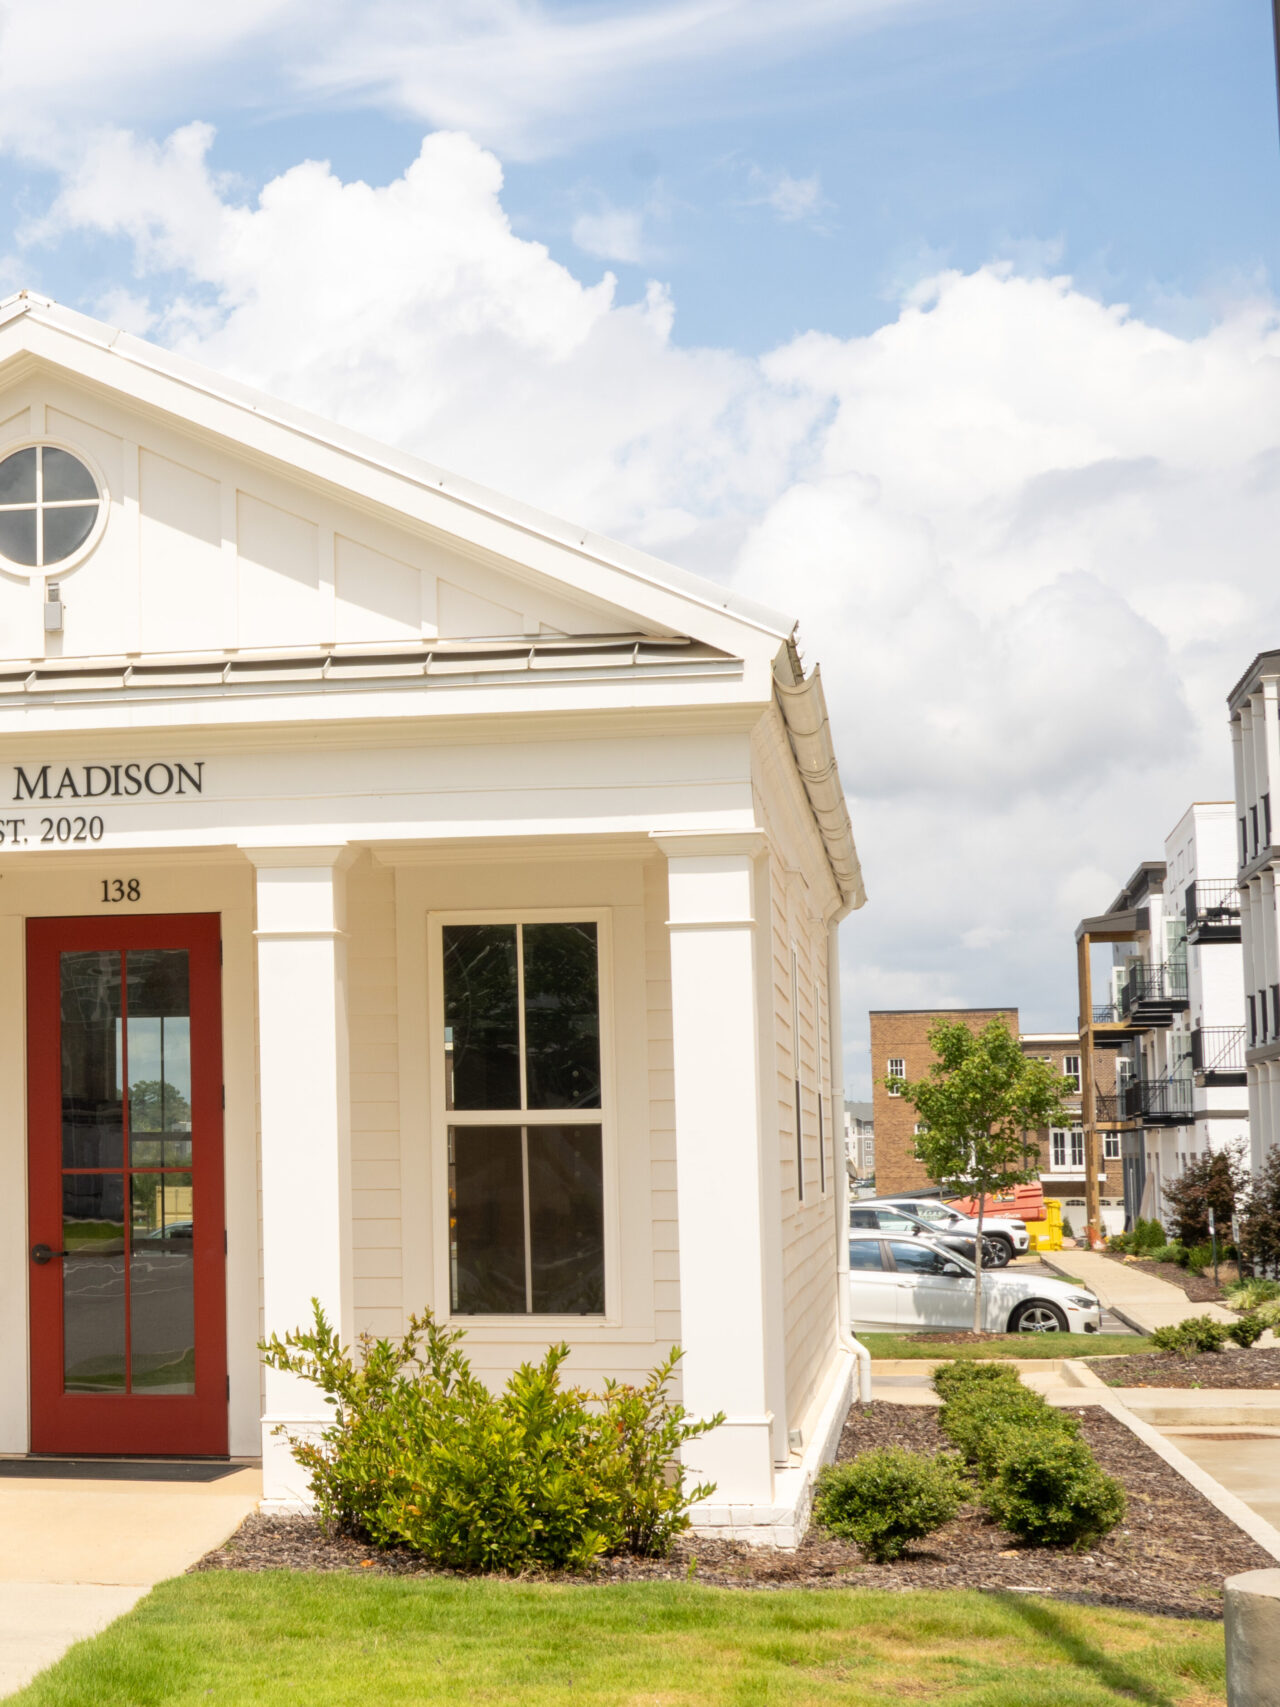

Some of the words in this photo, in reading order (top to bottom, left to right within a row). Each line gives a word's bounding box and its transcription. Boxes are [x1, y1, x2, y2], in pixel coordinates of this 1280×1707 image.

[13, 762, 205, 800] MADISON
[40, 816, 104, 842] 2020
[101, 878, 141, 902] 138
